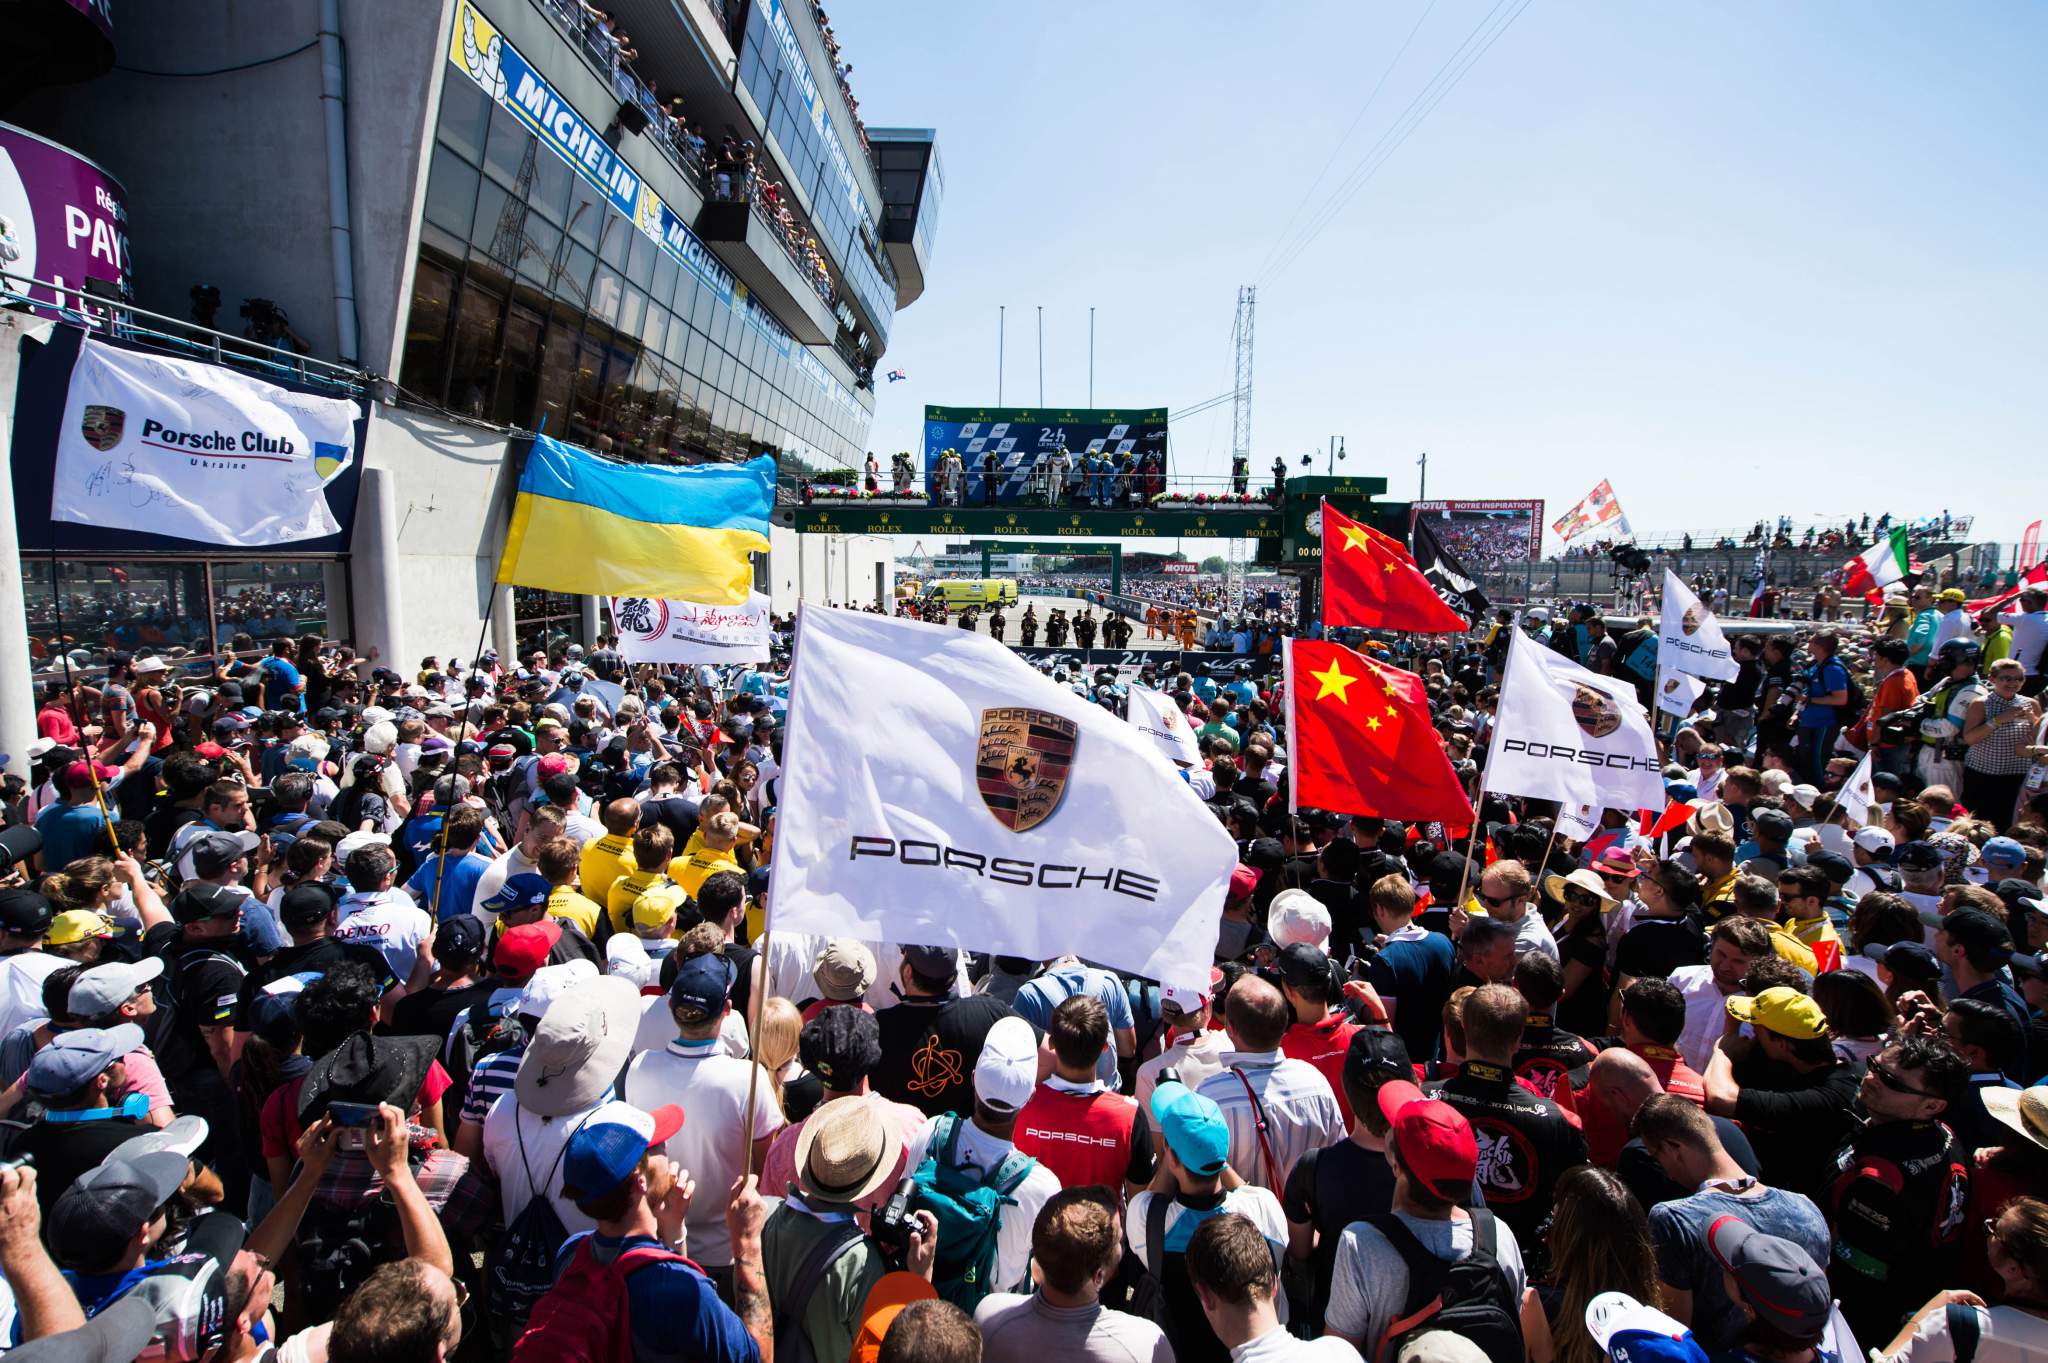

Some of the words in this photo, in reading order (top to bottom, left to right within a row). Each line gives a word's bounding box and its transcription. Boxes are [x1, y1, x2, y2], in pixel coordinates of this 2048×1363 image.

[774, 7, 816, 102] MICHELIN
[515, 71, 637, 204] MICHELIN
[667, 223, 734, 297] MICHELIN
[751, 302, 793, 350] MICHELIN
[141, 418, 236, 453] Porsche
[240, 431, 295, 455] Club
[190, 458, 247, 471] Ukraine
[1333, 486, 1361, 494] ROLEX
[1411, 501, 1449, 510] MOTUL
[807, 525, 841, 533] ROLEX
[867, 525, 902, 533] ROLEX
[930, 525, 966, 534] ROLEX
[994, 526, 1030, 535] ROLEX
[1057, 527, 1093, 536] ROLEX
[1121, 528, 1156, 536] ROLEX
[1184, 528, 1219, 537] ROLEX
[1246, 529, 1280, 538] ROLEX
[1164, 564, 1197, 573] MOTUL
[985, 709, 1076, 738] PORSCHE
[850, 835, 1161, 902] PORSCHE
[335, 923, 391, 939] DENSO
[1026, 1127, 1117, 1148] PORSCHE
